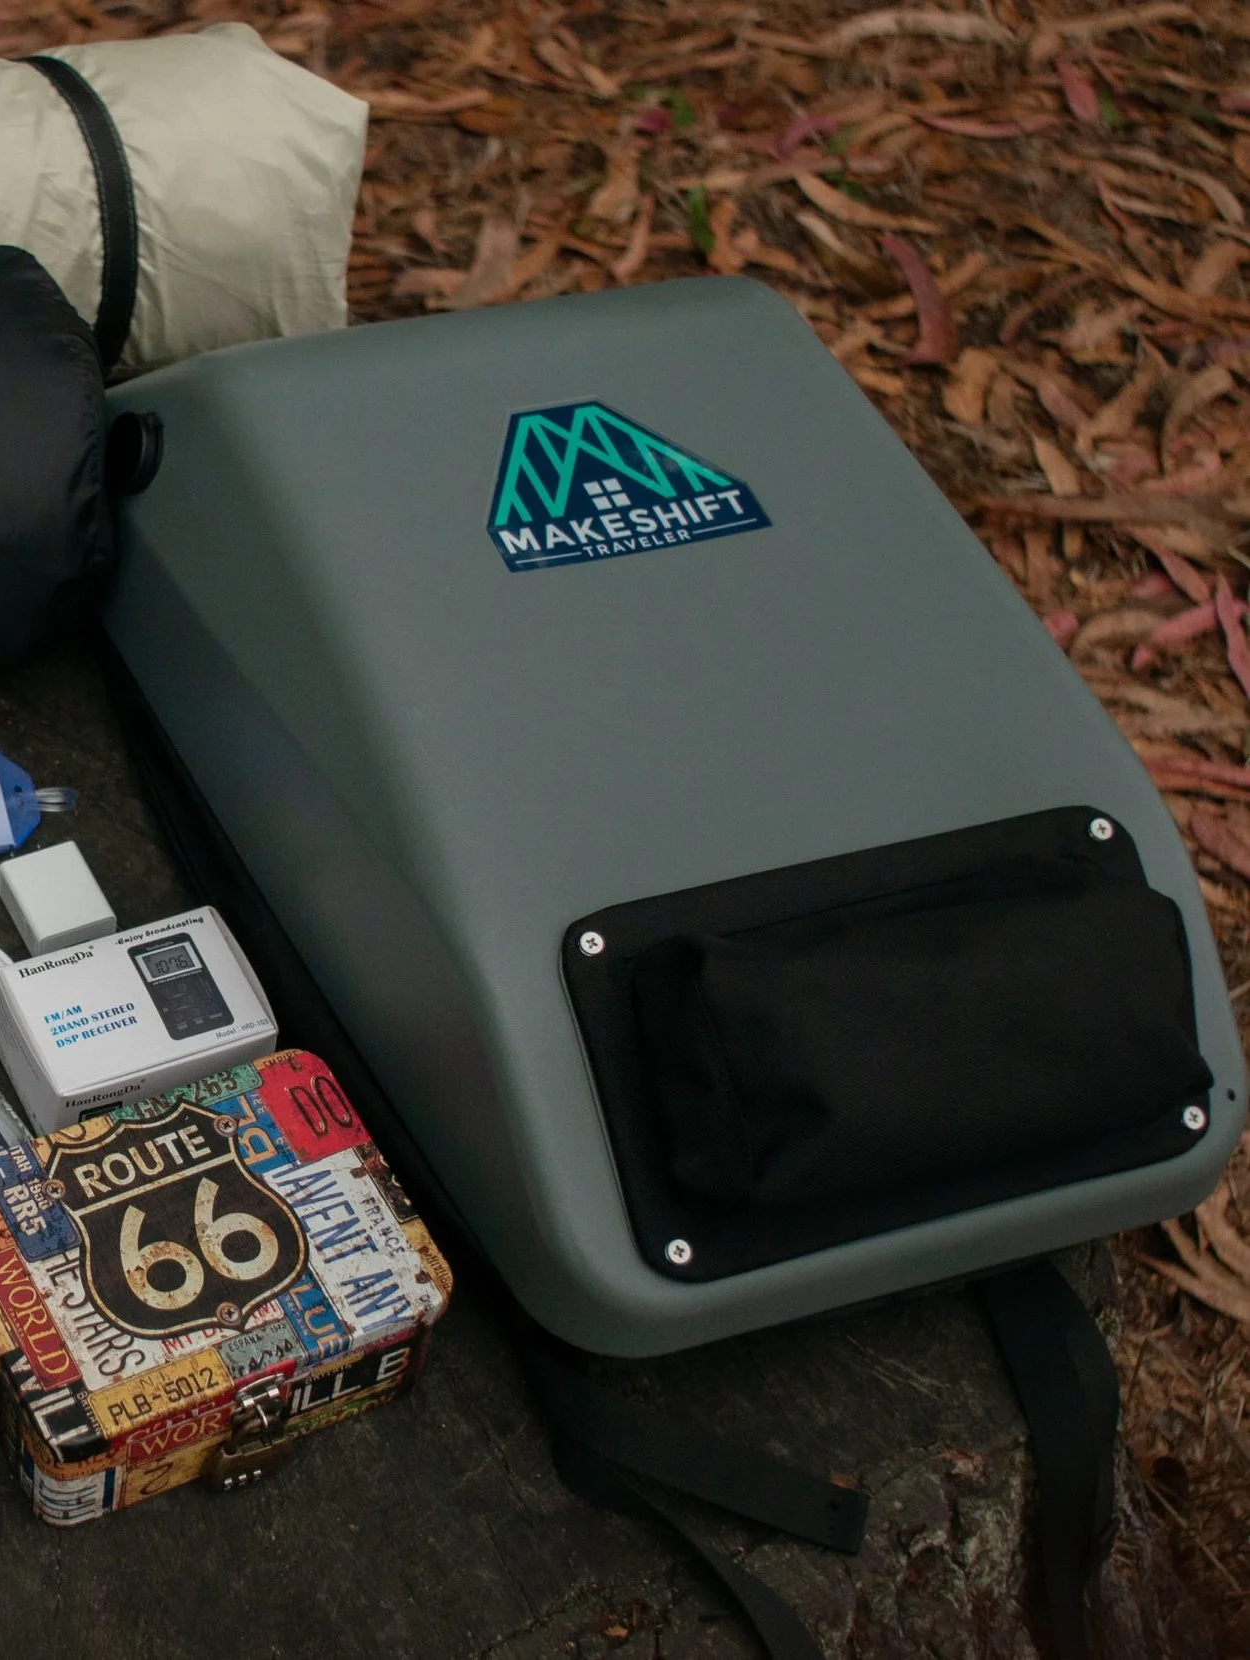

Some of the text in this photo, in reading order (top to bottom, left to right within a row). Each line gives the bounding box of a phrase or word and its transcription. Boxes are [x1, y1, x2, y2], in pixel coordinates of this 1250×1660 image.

[498, 490, 744, 554] MAKESHIFT
[582, 530, 691, 558] TRAVELER
[44, 1005, 82, 1025] FM/AM
[50, 1002, 135, 1036] 2BAND STEREO
[56, 1016, 138, 1048] DSP RECEIVER
[285, 1075, 353, 1138] DO
[73, 1124, 211, 1199] ROUTE
[119, 1177, 279, 1310] 66
[362, 1196, 406, 1257] FRANCE
[288, 1282, 345, 1361] LUE
[340, 1268, 416, 1333] ANY
[108, 1368, 221, 1427] PLB-5012
[290, 1372, 362, 1415] ILL
